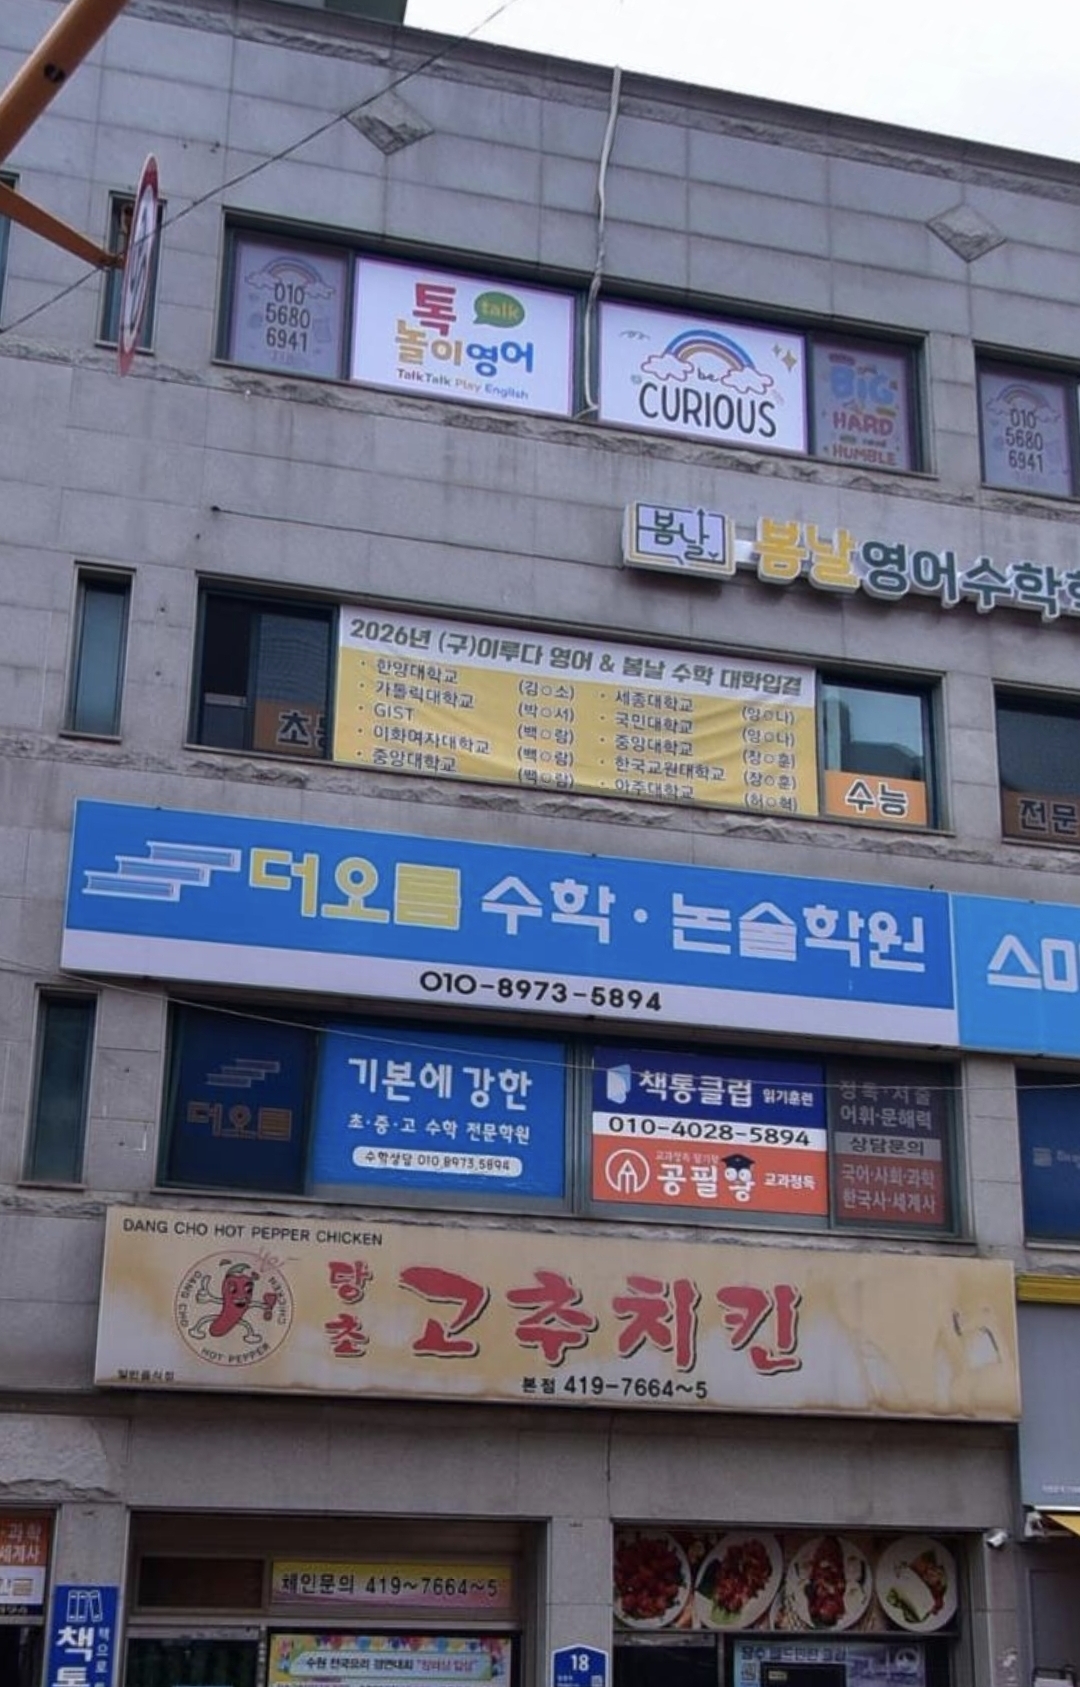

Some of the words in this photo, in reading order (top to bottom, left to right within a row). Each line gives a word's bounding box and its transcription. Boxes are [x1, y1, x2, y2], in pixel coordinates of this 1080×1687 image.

[274, 282, 306, 306] 010
[265, 302, 311, 329] 5680
[412, 282, 457, 337] 톡
[481, 300, 520, 321] talk
[266, 326, 308, 352] 6941
[395, 318, 534, 378] 놀이영어
[697, 367, 720, 383] be
[831, 364, 894, 406] BIG
[454, 378, 482, 393] Play
[484, 383, 530, 401] English
[638, 381, 777, 438] CURIOUS
[1009, 407, 1037, 429] 010
[832, 410, 895, 437] HARD
[1004, 426, 1044, 452] 5680
[832, 442, 896, 467] HUMBLE
[1007, 449, 1044, 474] 6941
[653, 507, 714, 562] 봄날
[350, 617, 432, 651] 2026년
[438, 632, 543, 667] (구)이루다
[551, 644, 593, 672] 영어
[600, 652, 616, 674] &
[622, 653, 666, 682] 봄날
[671, 659, 714, 688] 수학
[719, 664, 803, 697] 대학입결
[377, 658, 459, 685] 한양대학교
[375, 680, 475, 710] 가톨릭대학교
[615, 688, 694, 712] 세종대학교
[373, 703, 415, 721] GIST
[615, 711, 694, 734] 국민대학교
[373, 725, 491, 755] 이화여자대학교
[615, 733, 694, 757] 중앙대학교
[372, 747, 457, 773] 중앙대학교
[615, 755, 726, 781] 한국교원대학교
[614, 778, 694, 800] 아주대학교
[845, 778, 909, 819] 수능
[1018, 798, 1079, 836] 전문
[248, 846, 462, 931] 더오름
[420, 970, 662, 1012] 010-8973-5894
[347, 1057, 454, 1103] 기본에
[462, 1065, 533, 1111] 강한
[638, 1068, 753, 1109] 책통클럽
[762, 1087, 814, 1108] 읽기훈련
[425, 1118, 458, 1140] 수학
[466, 1121, 531, 1145] 전문학원
[608, 1115, 810, 1147] 010-4028-5894
[365, 1149, 413, 1167] 수학상담
[849, 1136, 925, 1157] 상담문의
[763, 1171, 816, 1191] 교과정독
[122, 1216, 169, 1235] DANG
[174, 1220, 208, 1237] CHO
[214, 1223, 245, 1240] HOT
[251, 1225, 311, 1243] PEPPER
[316, 1228, 383, 1246] CHICKEN
[399, 1265, 803, 1376] 고추치킨
[200, 1345, 225, 1362] HOT
[227, 1341, 271, 1364] PEPPER
[522, 1376, 557, 1395] 본점
[563, 1375, 708, 1400] 419-7664~5
[281, 1572, 355, 1596] 체인문의
[570, 1653, 590, 1672] 18
